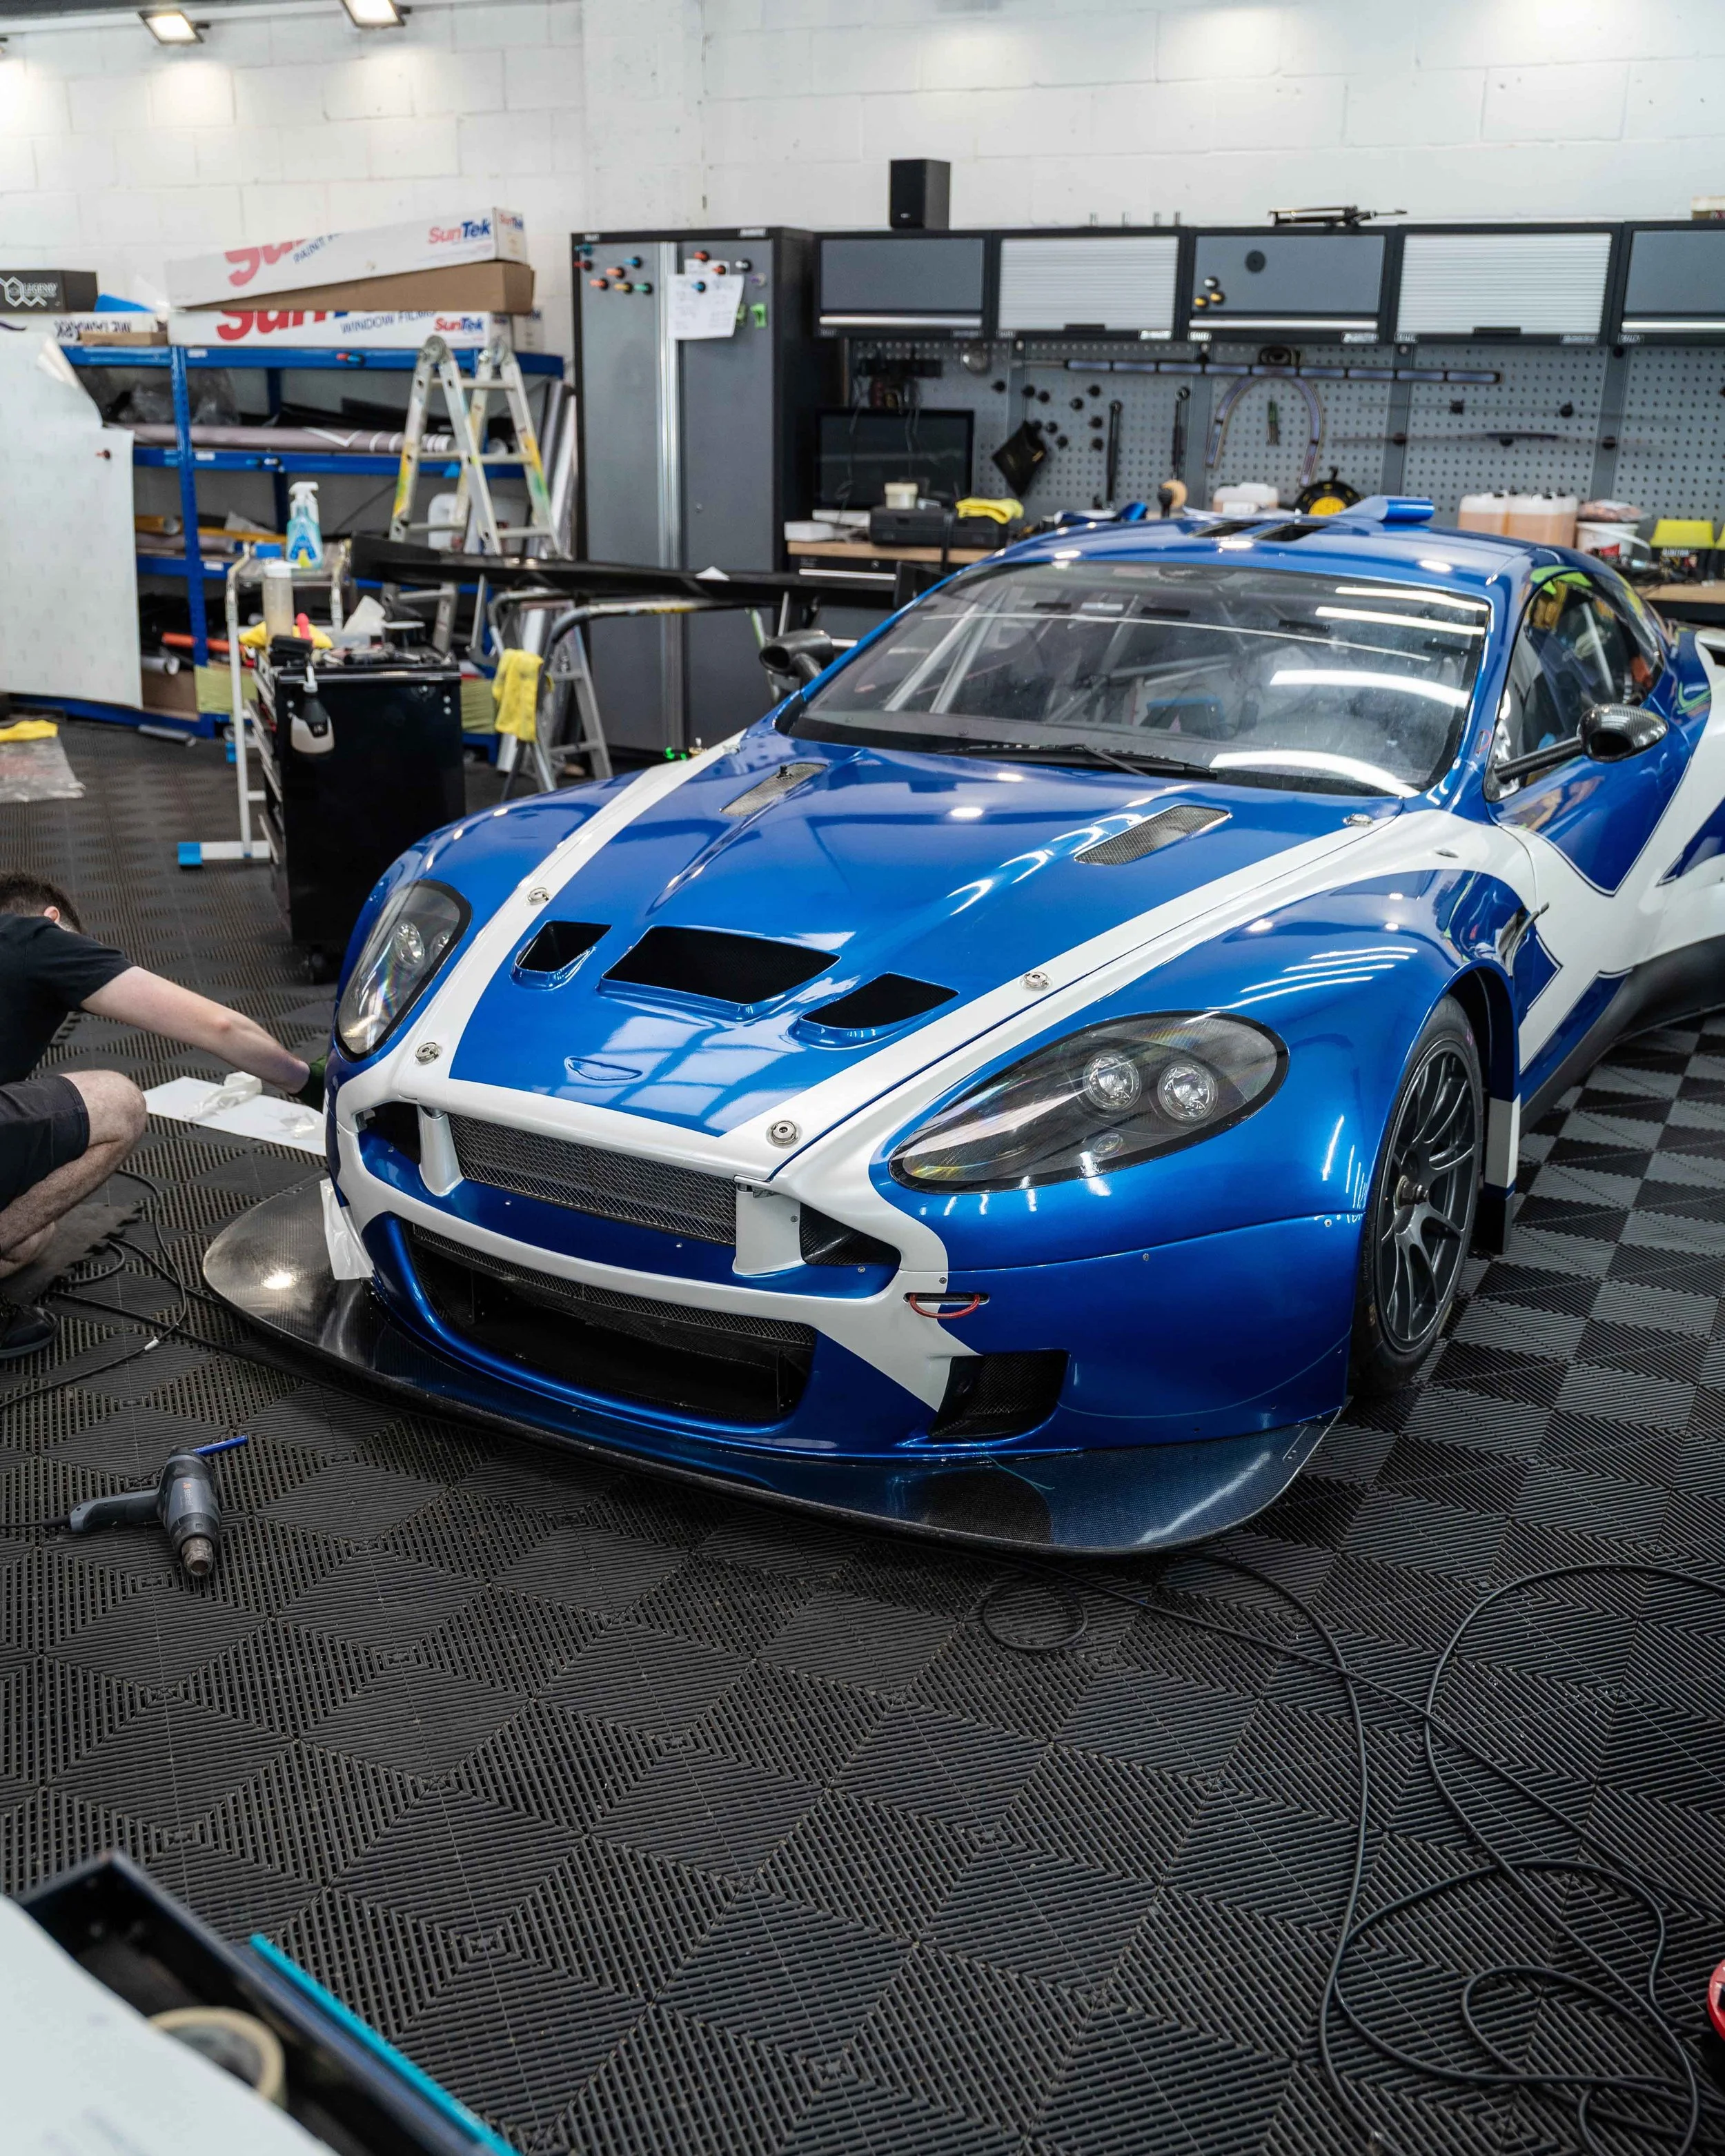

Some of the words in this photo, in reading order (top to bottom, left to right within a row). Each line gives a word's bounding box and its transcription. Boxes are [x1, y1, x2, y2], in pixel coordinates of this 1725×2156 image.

[499, 213, 523, 230] SunTek
[428, 219, 491, 244] SunTek
[340, 314, 395, 334] WINDOW
[434, 317, 483, 331] SunTek
